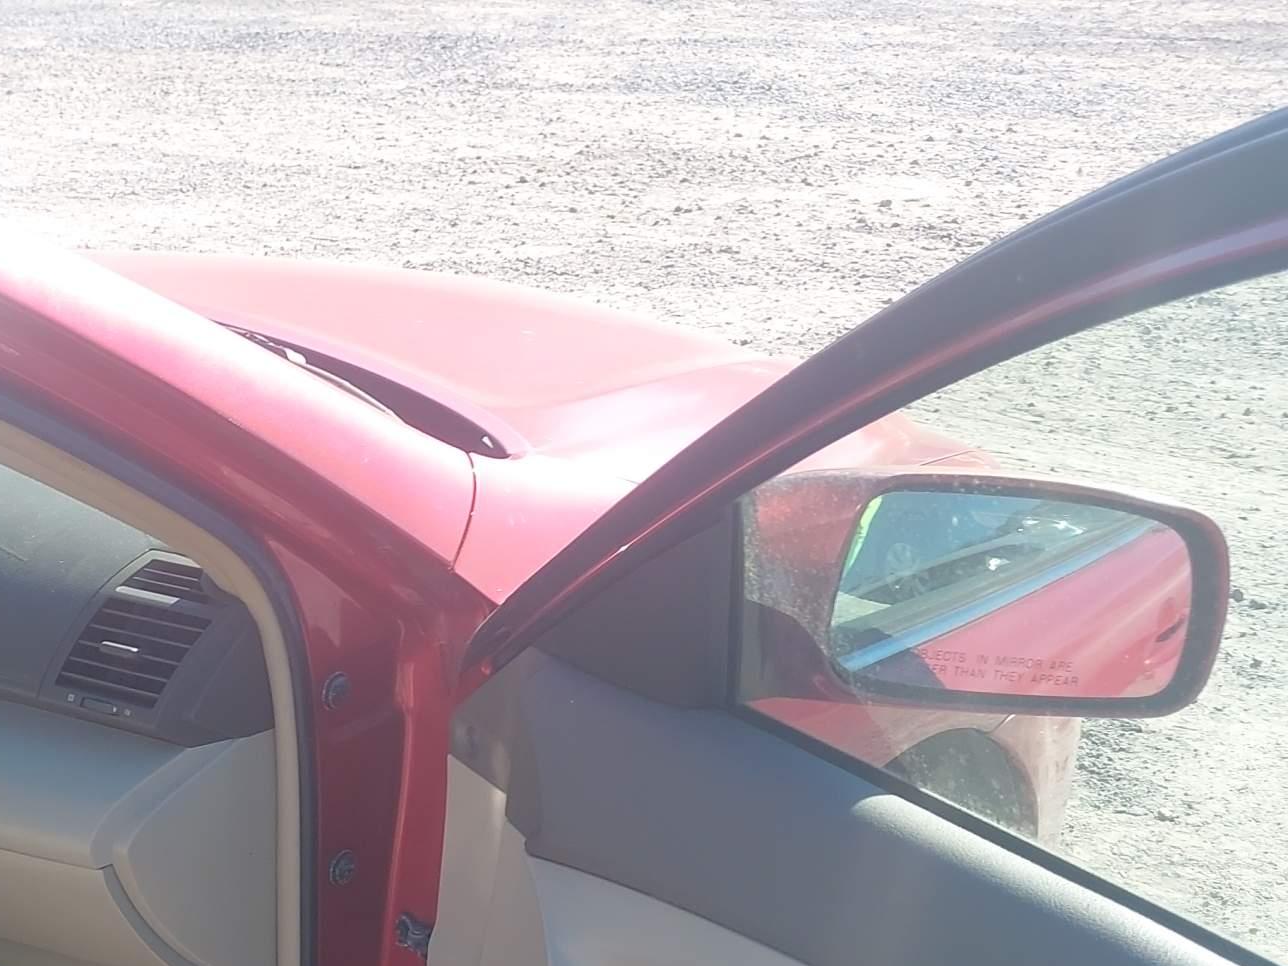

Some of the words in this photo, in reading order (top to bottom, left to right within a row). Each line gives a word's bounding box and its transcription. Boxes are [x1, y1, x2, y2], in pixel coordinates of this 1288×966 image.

[976, 653, 990, 665] IN
[993, 654, 1042, 669] MIRROR
[1048, 659, 1073, 673] ARE
[955, 665, 985, 679] THAN
[993, 669, 1025, 684] THEY
[1031, 672, 1080, 687] APPEAR
